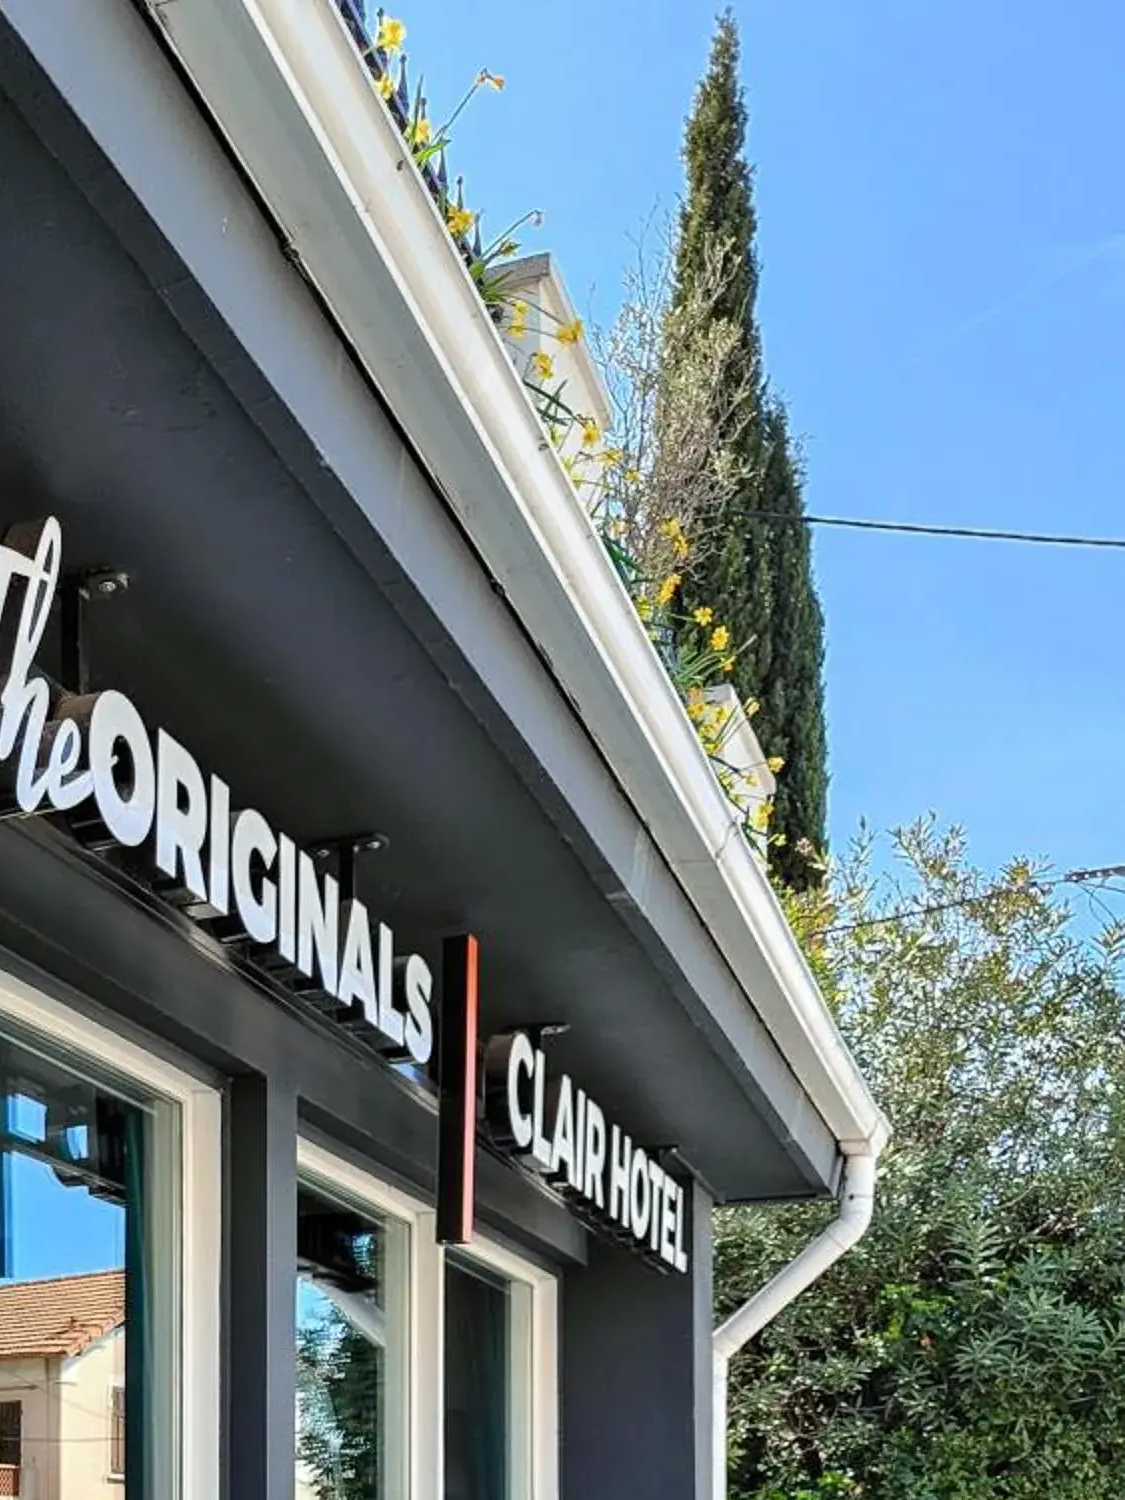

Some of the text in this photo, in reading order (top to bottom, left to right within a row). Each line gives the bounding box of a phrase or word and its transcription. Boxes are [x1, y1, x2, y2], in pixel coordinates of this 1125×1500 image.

[88, 689, 433, 1065] ORIGINALS
[507, 1031, 688, 1274] CLAIR HOTEL
